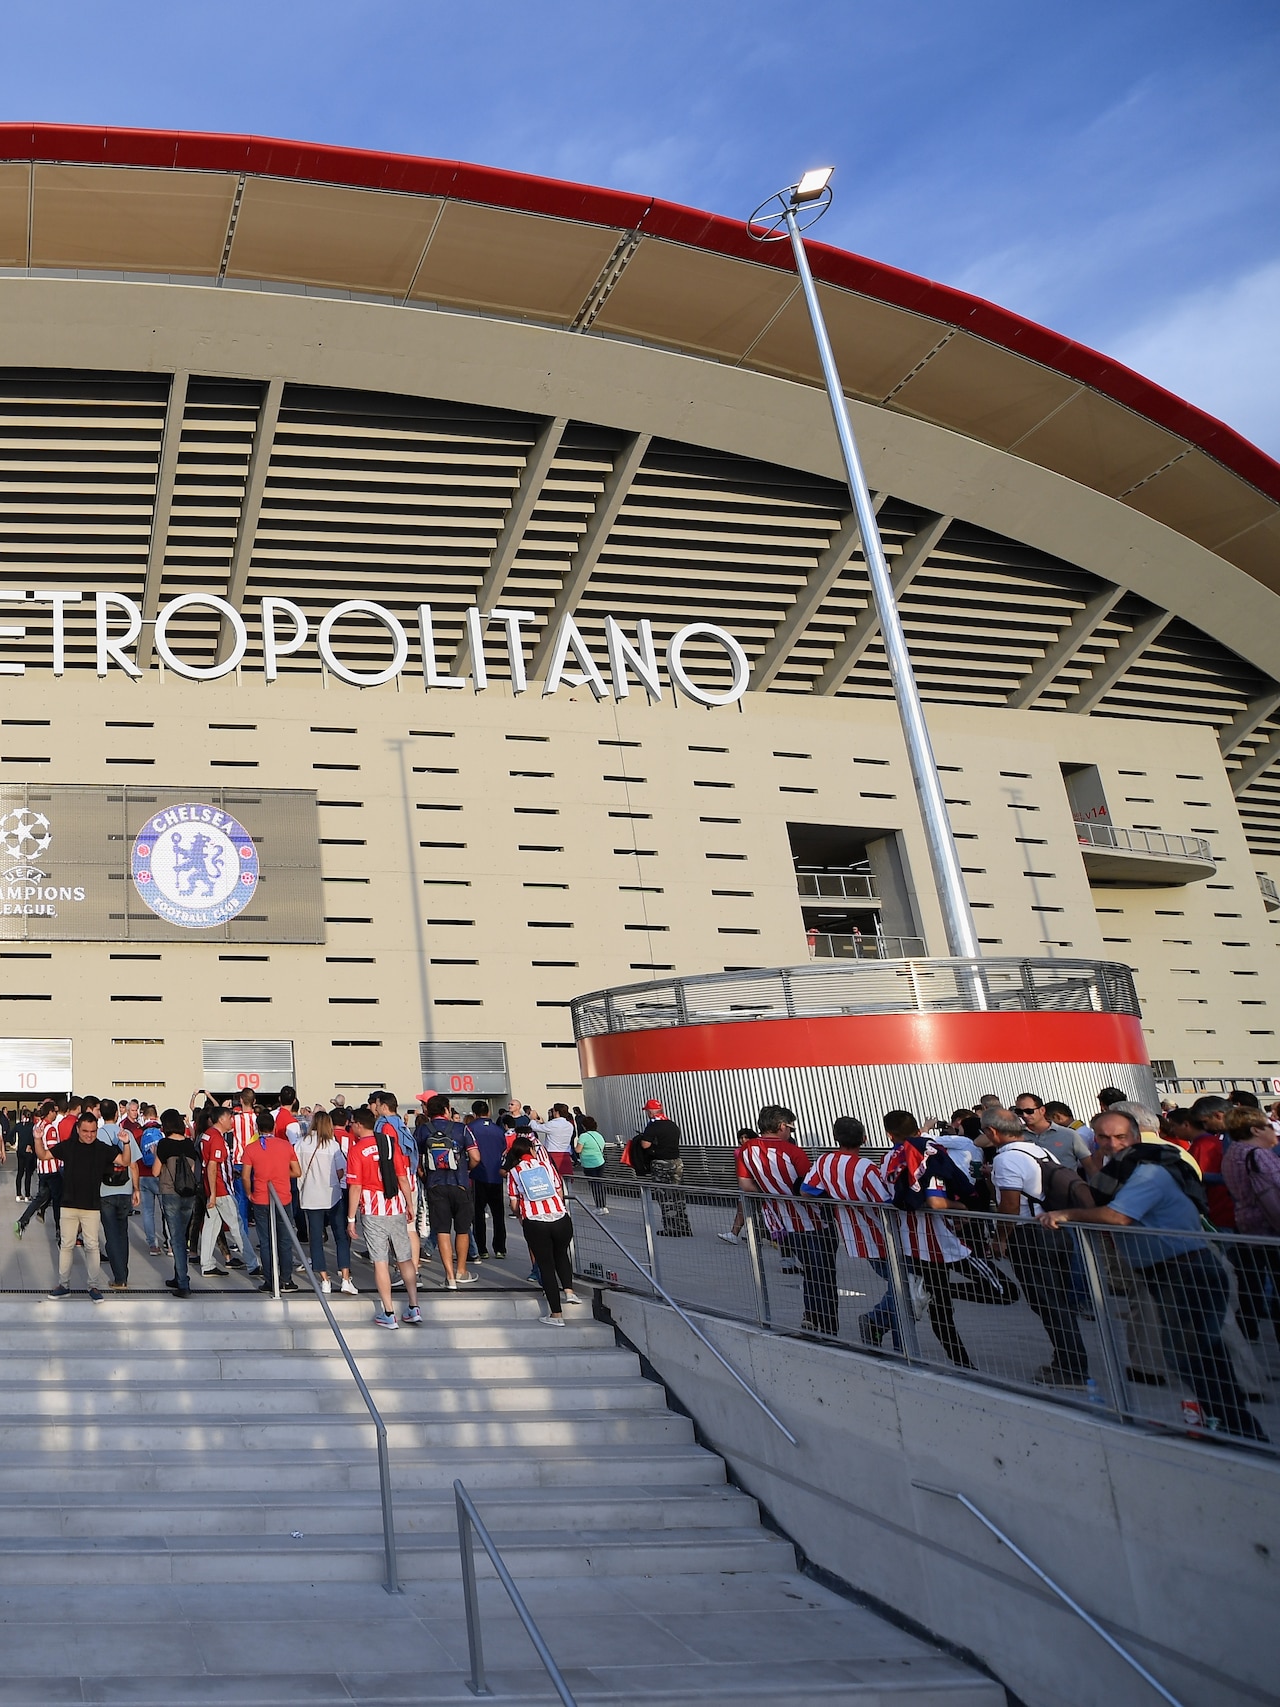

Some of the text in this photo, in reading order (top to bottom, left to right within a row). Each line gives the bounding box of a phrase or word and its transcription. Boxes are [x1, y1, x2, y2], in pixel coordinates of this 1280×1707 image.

[152, 807, 234, 836] CHELSEA
[5, 868, 42, 883] UEFA
[154, 898, 239, 922] FOOTBALL CLUB
[18, 1072, 37, 1089] 10
[236, 1072, 260, 1090] 09
[450, 1074, 475, 1092] 08
